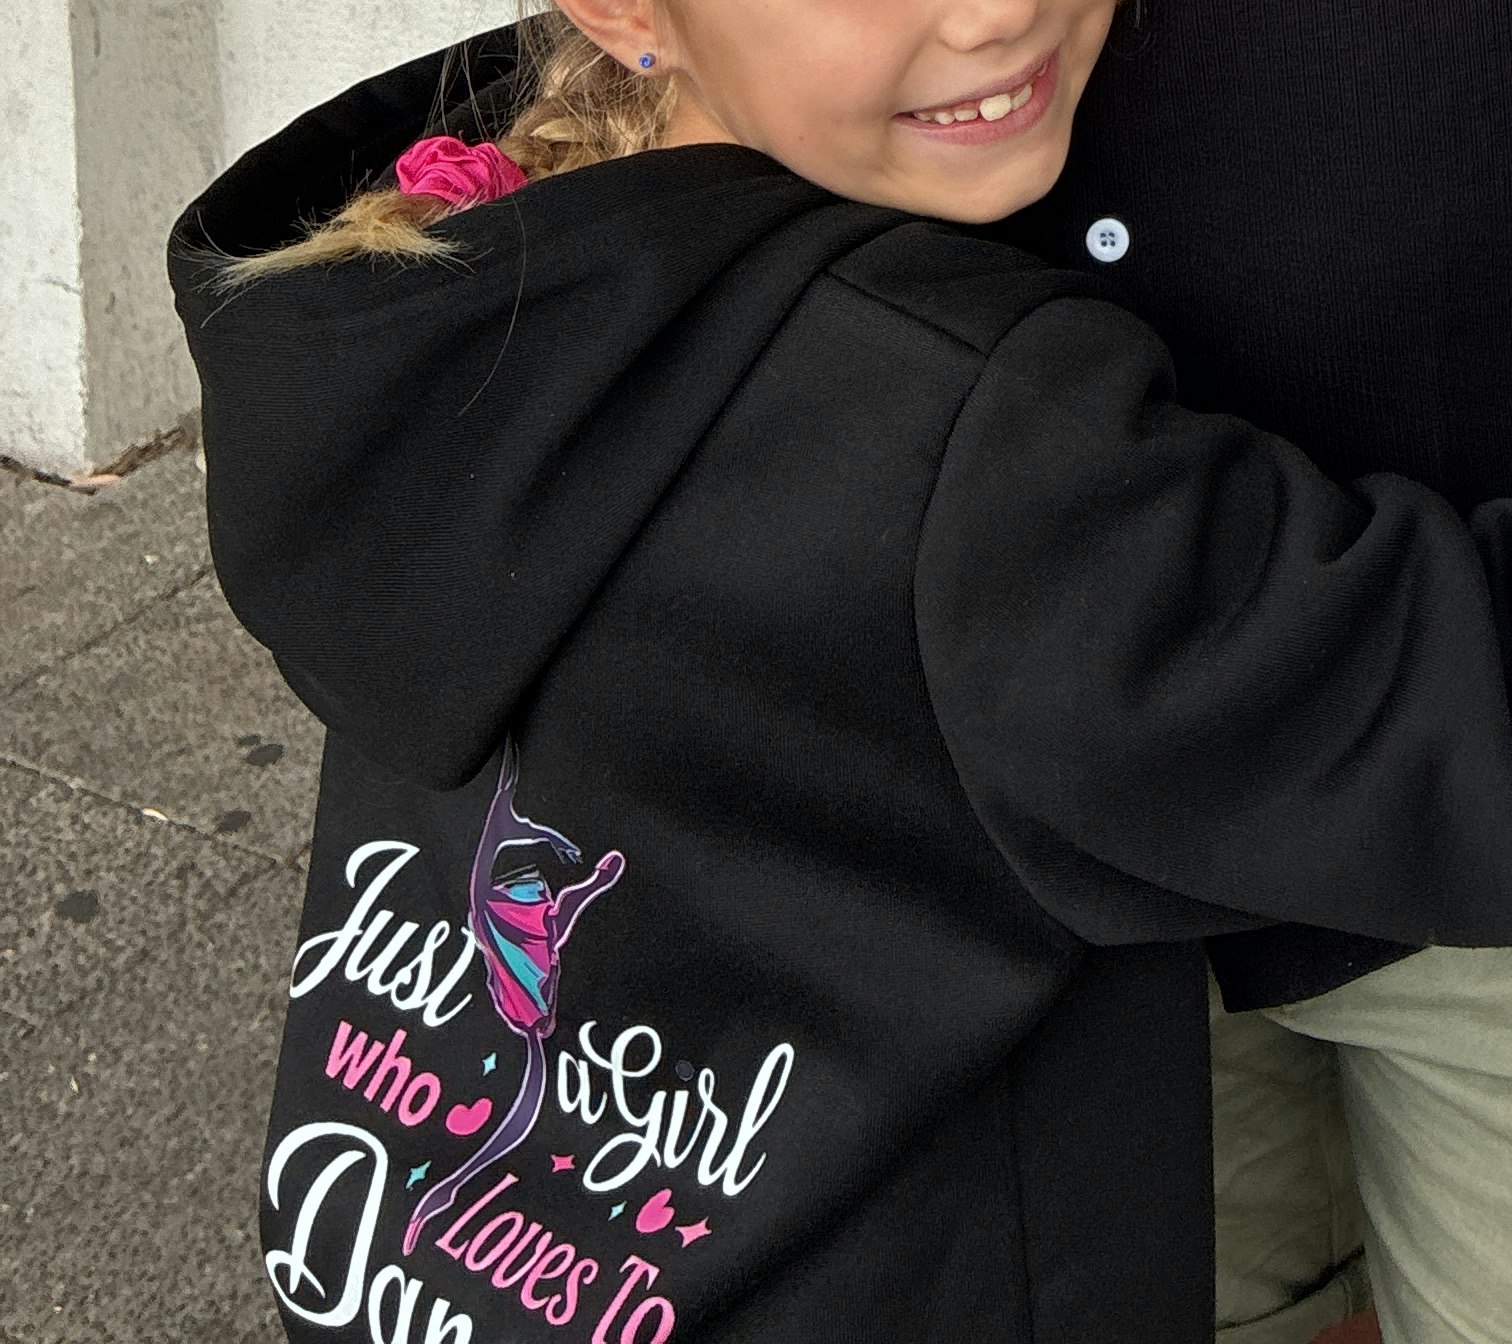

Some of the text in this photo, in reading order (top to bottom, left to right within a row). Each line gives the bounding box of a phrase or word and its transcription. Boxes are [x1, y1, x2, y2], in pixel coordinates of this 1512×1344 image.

[289, 840, 486, 1028] Just
[325, 1020, 442, 1127] who
[557, 1020, 795, 1197] a Girl
[435, 1172, 599, 1326] Loves
